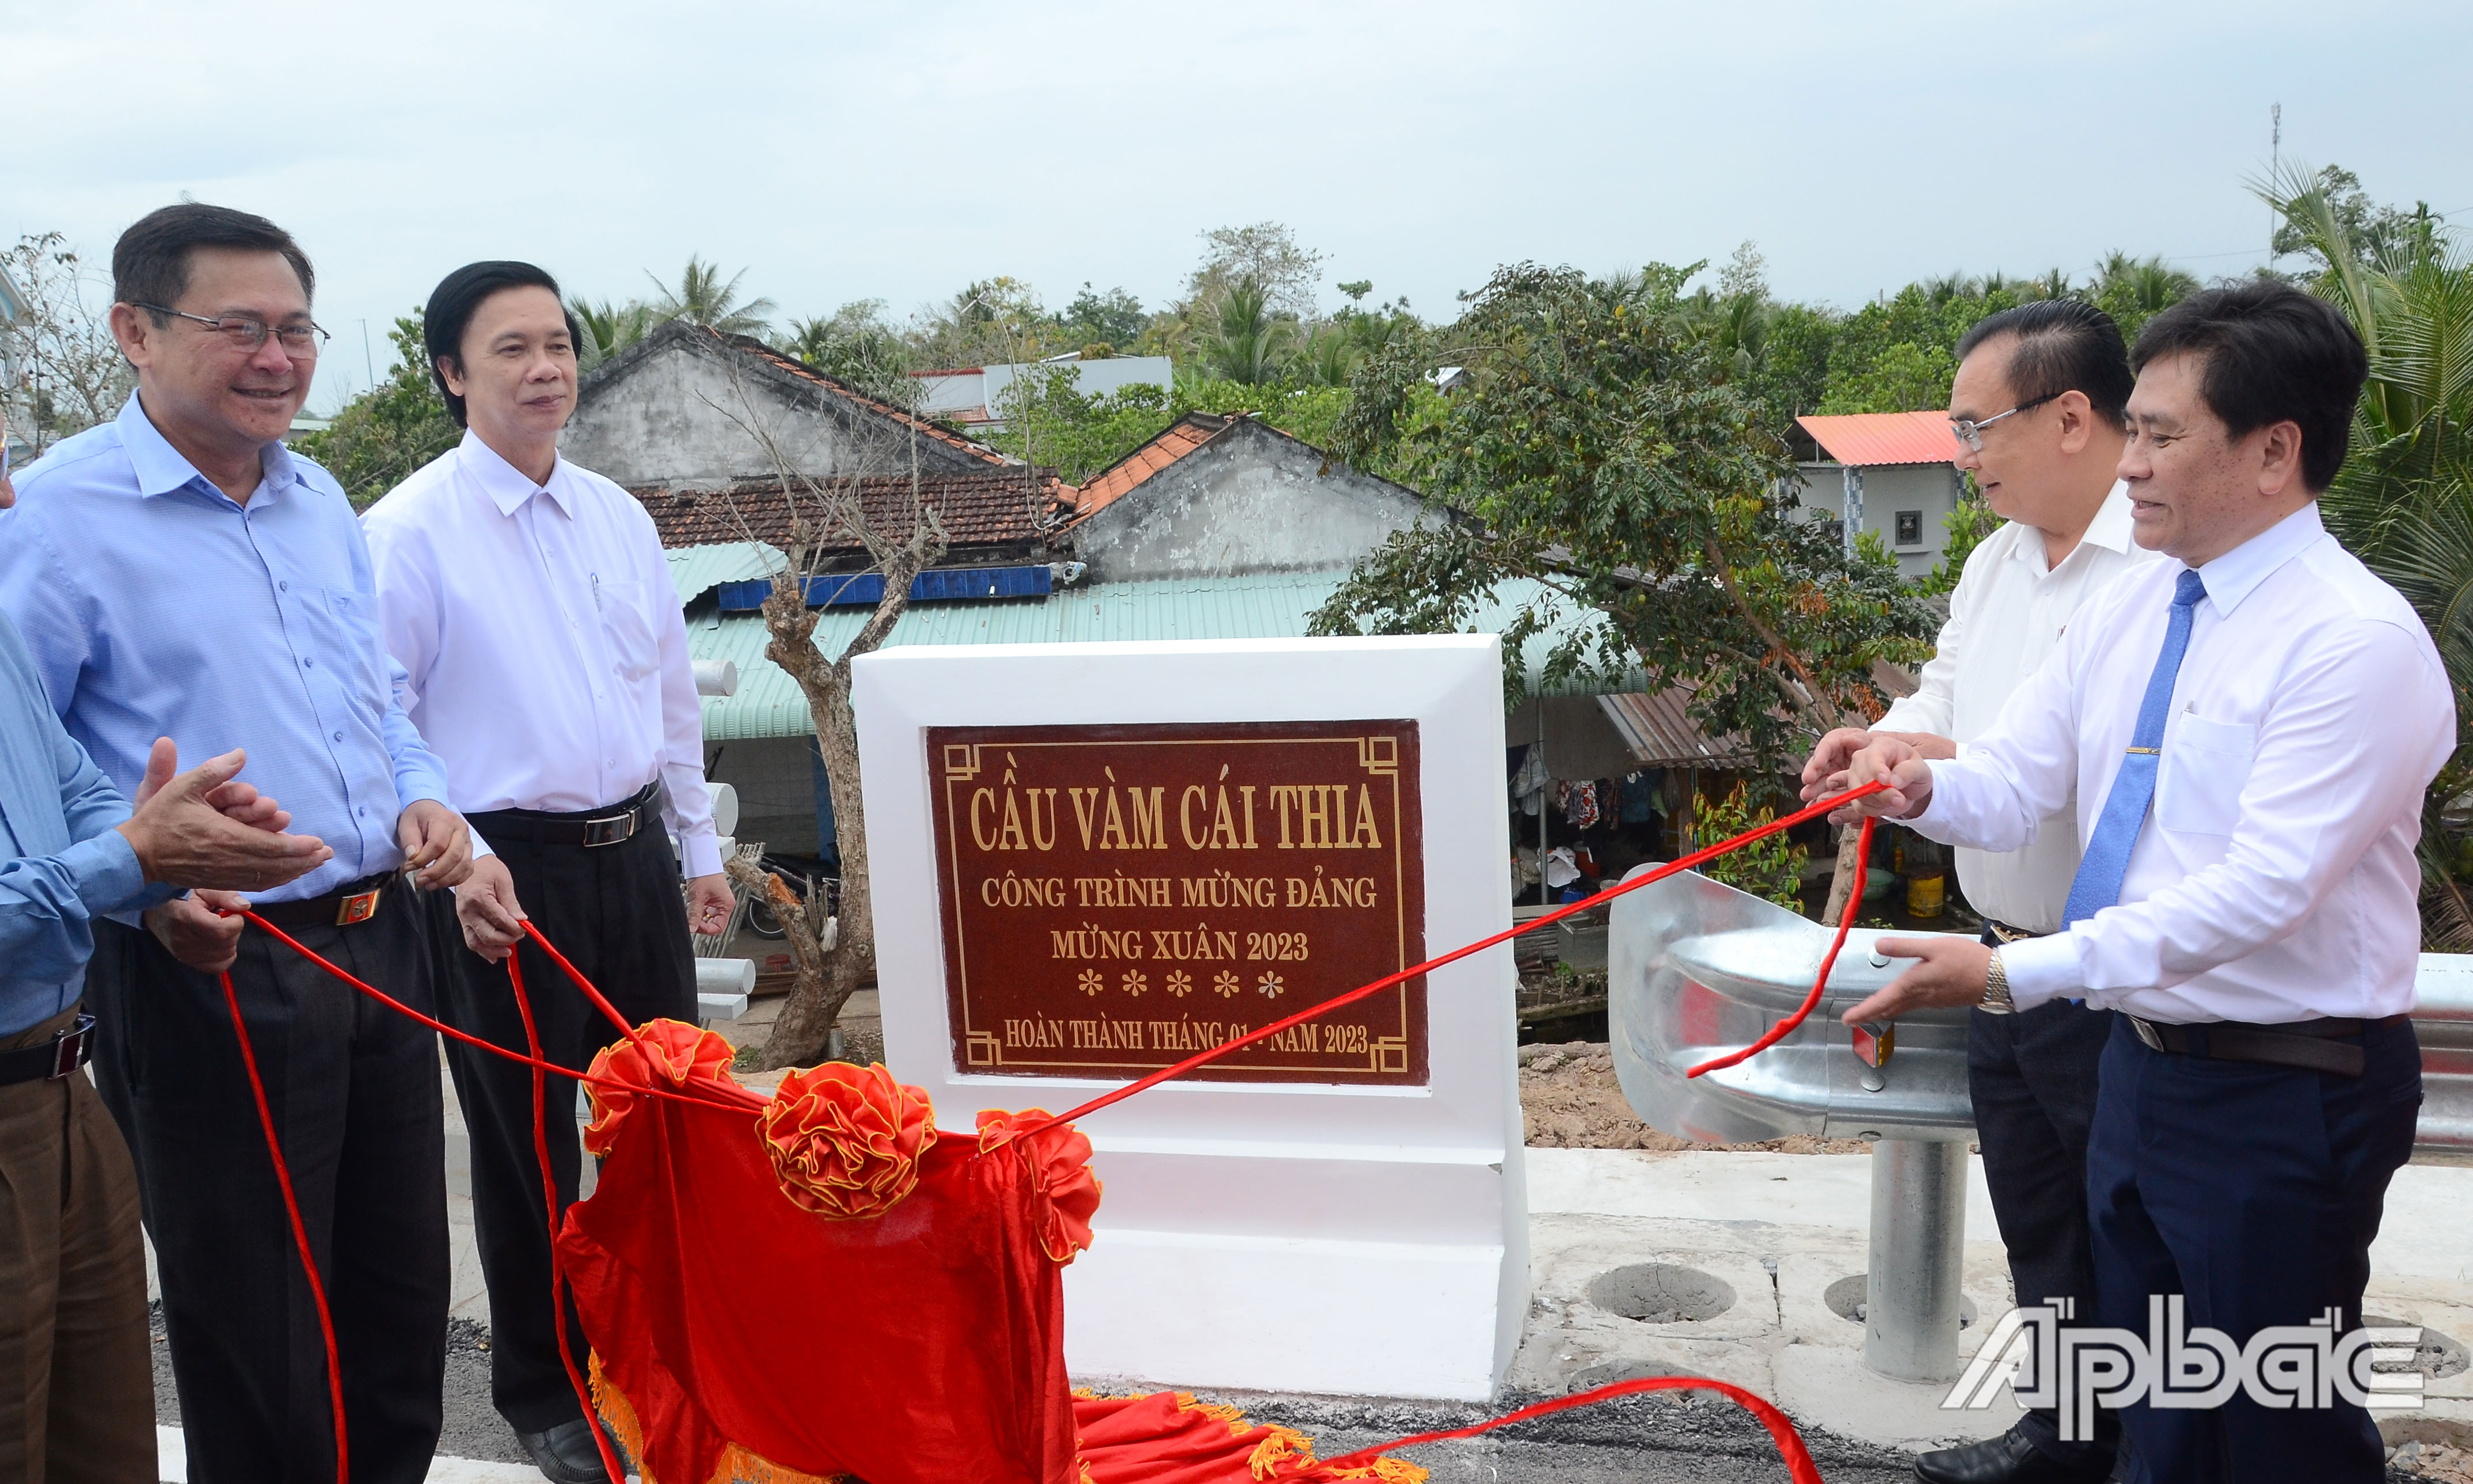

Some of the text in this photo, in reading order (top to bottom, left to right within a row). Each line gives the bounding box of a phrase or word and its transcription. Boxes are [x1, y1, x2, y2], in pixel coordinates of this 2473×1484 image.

[970, 751, 1382, 851] CẦU VÀM CÁI THIA
[982, 865, 1377, 908] CÔNG TRÌNH MỪNG ĐẢNG
[1051, 922, 1308, 961] MỪNG XUÂN 2023
[1005, 1010, 1064, 1048] HOÀN
[1069, 1011, 1144, 1049] THÀNH
[1149, 1012, 1224, 1051] THÁNG
[1325, 1025, 1368, 1053] 2023
